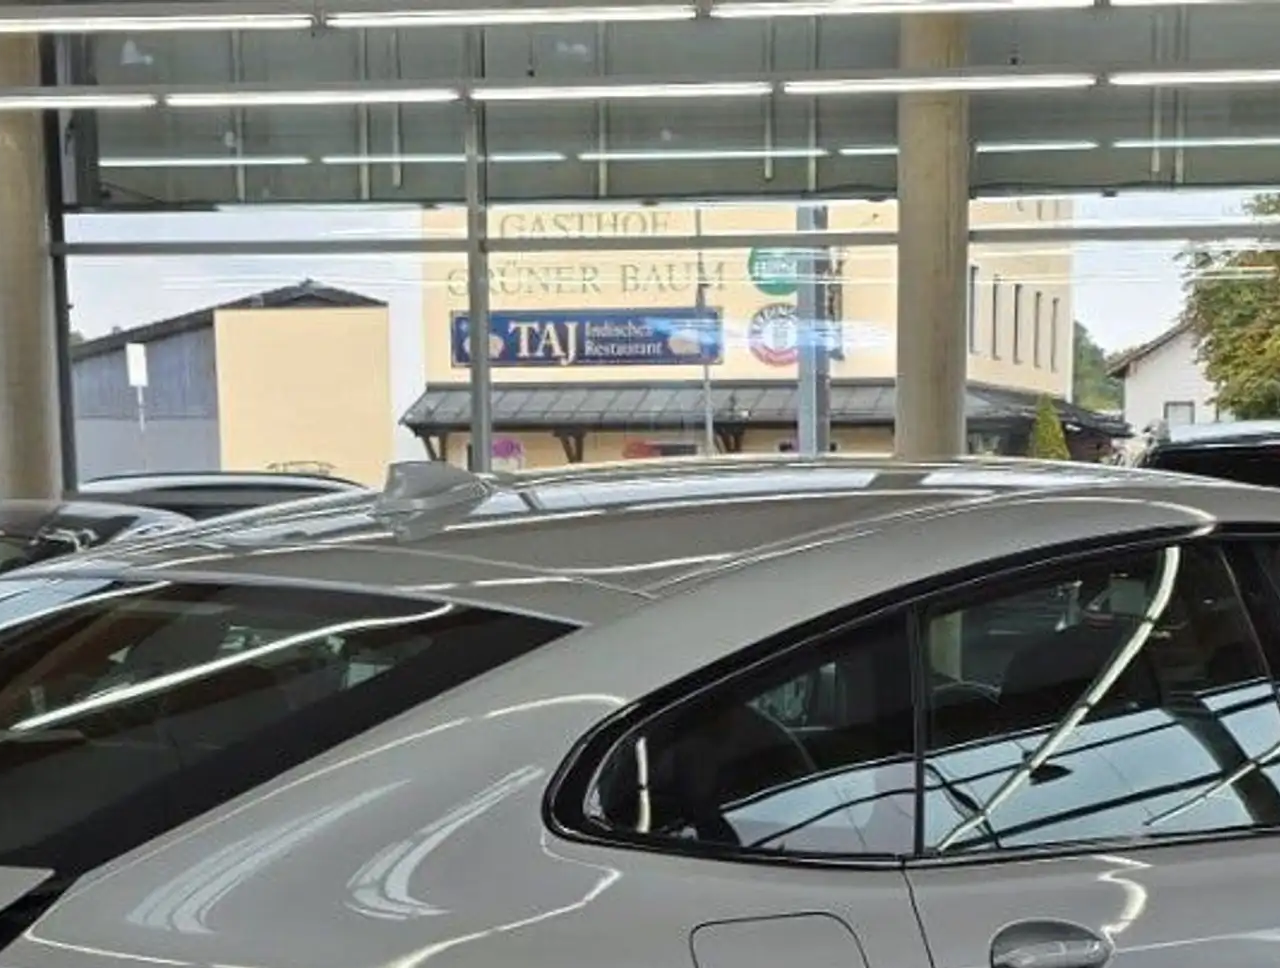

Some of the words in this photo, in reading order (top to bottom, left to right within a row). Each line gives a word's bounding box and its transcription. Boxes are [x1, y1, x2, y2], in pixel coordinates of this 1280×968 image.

[499, 211, 669, 238] GASTHOF
[619, 257, 728, 294] BAUM
[508, 320, 579, 366] TAJ
[584, 340, 663, 357] Restaurant
